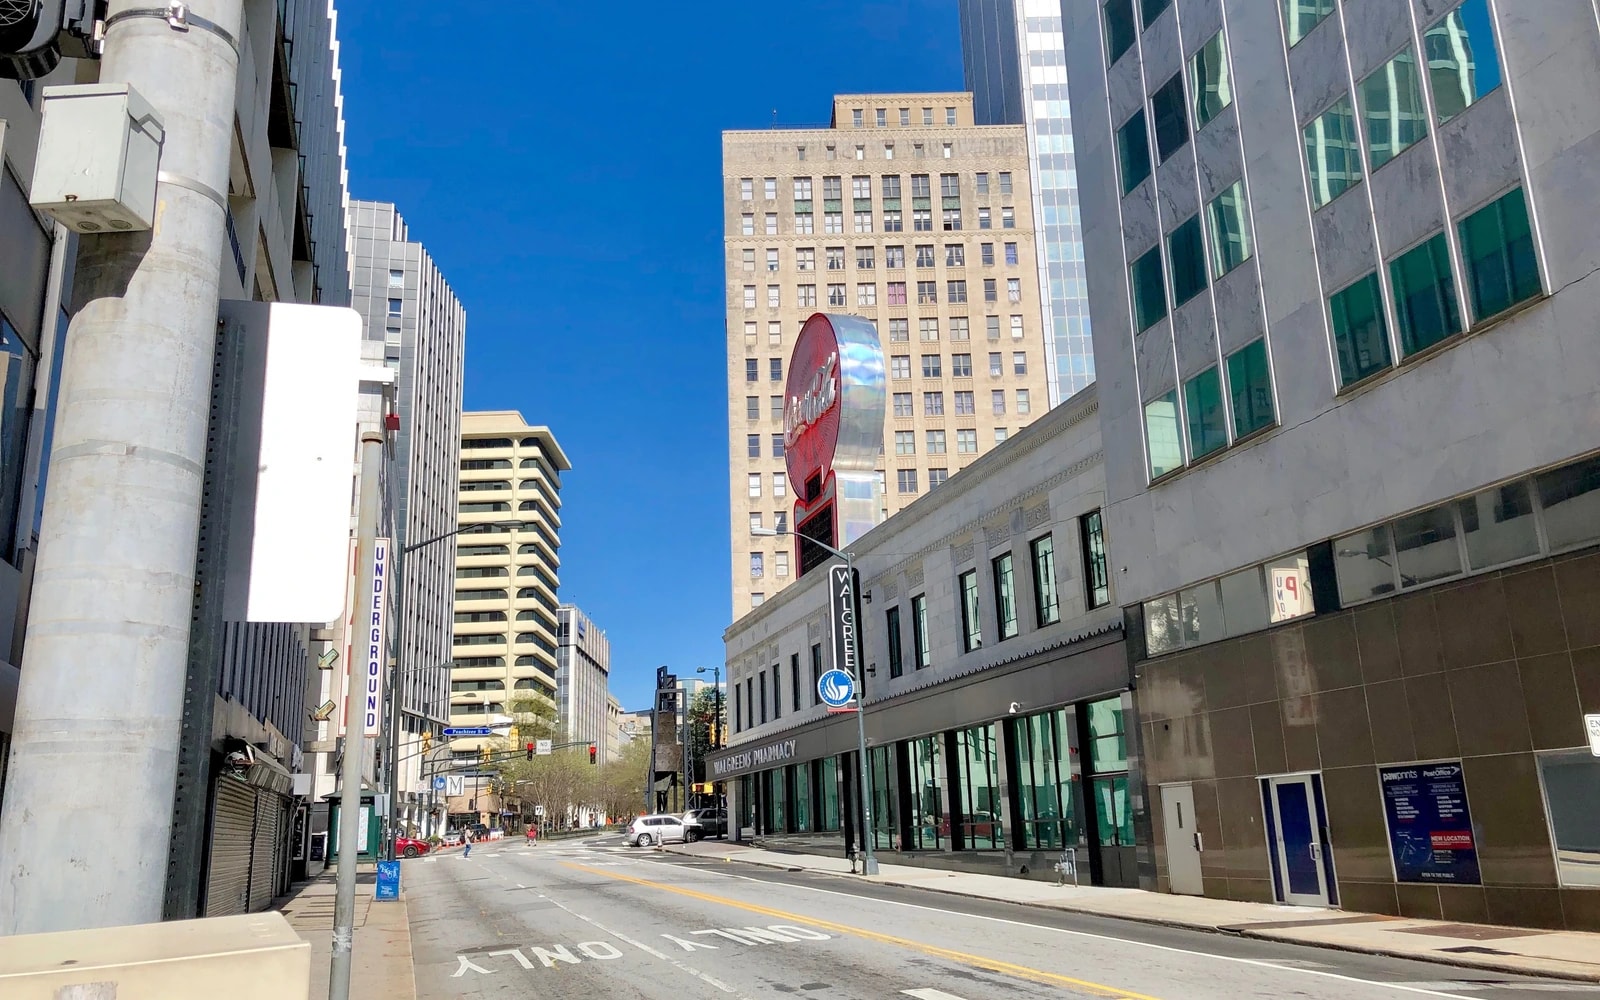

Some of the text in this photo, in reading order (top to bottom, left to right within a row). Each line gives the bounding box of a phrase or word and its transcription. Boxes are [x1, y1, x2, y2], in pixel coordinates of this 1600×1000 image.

[366, 547, 384, 727] UNDERGROUND
[713, 739, 797, 775] WALGREENS PHARMACY
[449, 777, 463, 795] M
[661, 925, 832, 951] ONLY
[450, 941, 623, 978] ONLY
